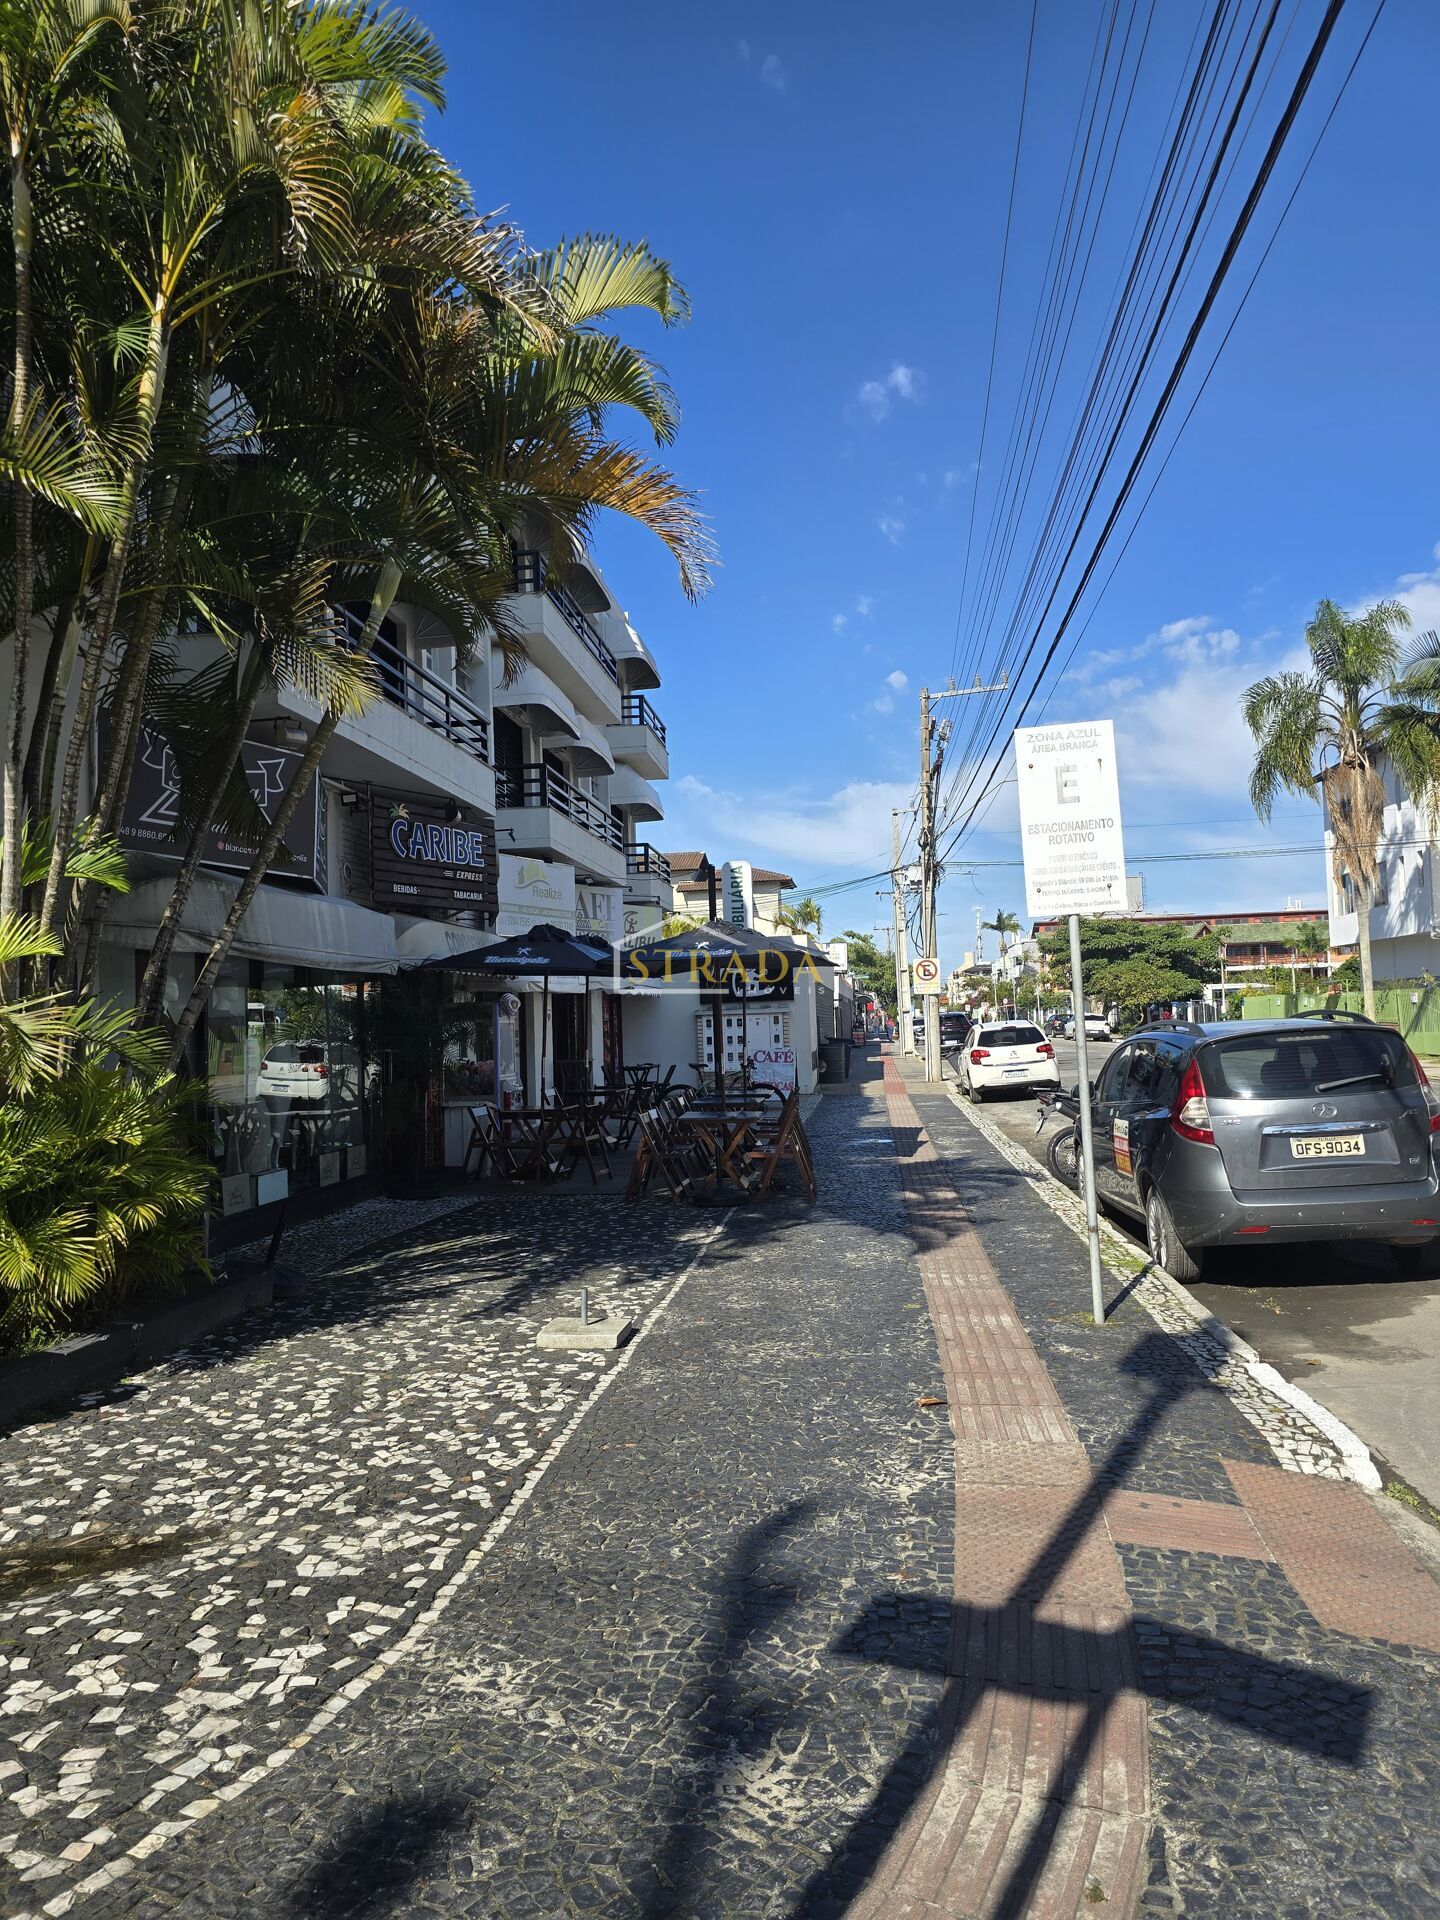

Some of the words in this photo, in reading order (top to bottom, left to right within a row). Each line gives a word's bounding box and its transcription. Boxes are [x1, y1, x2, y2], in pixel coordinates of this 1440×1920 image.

[1027, 732, 1064, 743] ZONA
[1067, 728, 1102, 740] AZUL
[1055, 764, 1080, 804] E
[1028, 818, 1114, 835] ESTACIONAMENTO
[391, 819, 485, 867] CARIBE
[1049, 832, 1095, 845] ROTATIVO
[456, 871, 483, 881] EXPRESS
[453, 891, 483, 900] TABACARIA
[532, 885, 563, 900] Realize
[753, 1049, 794, 1063] CAFÉ
